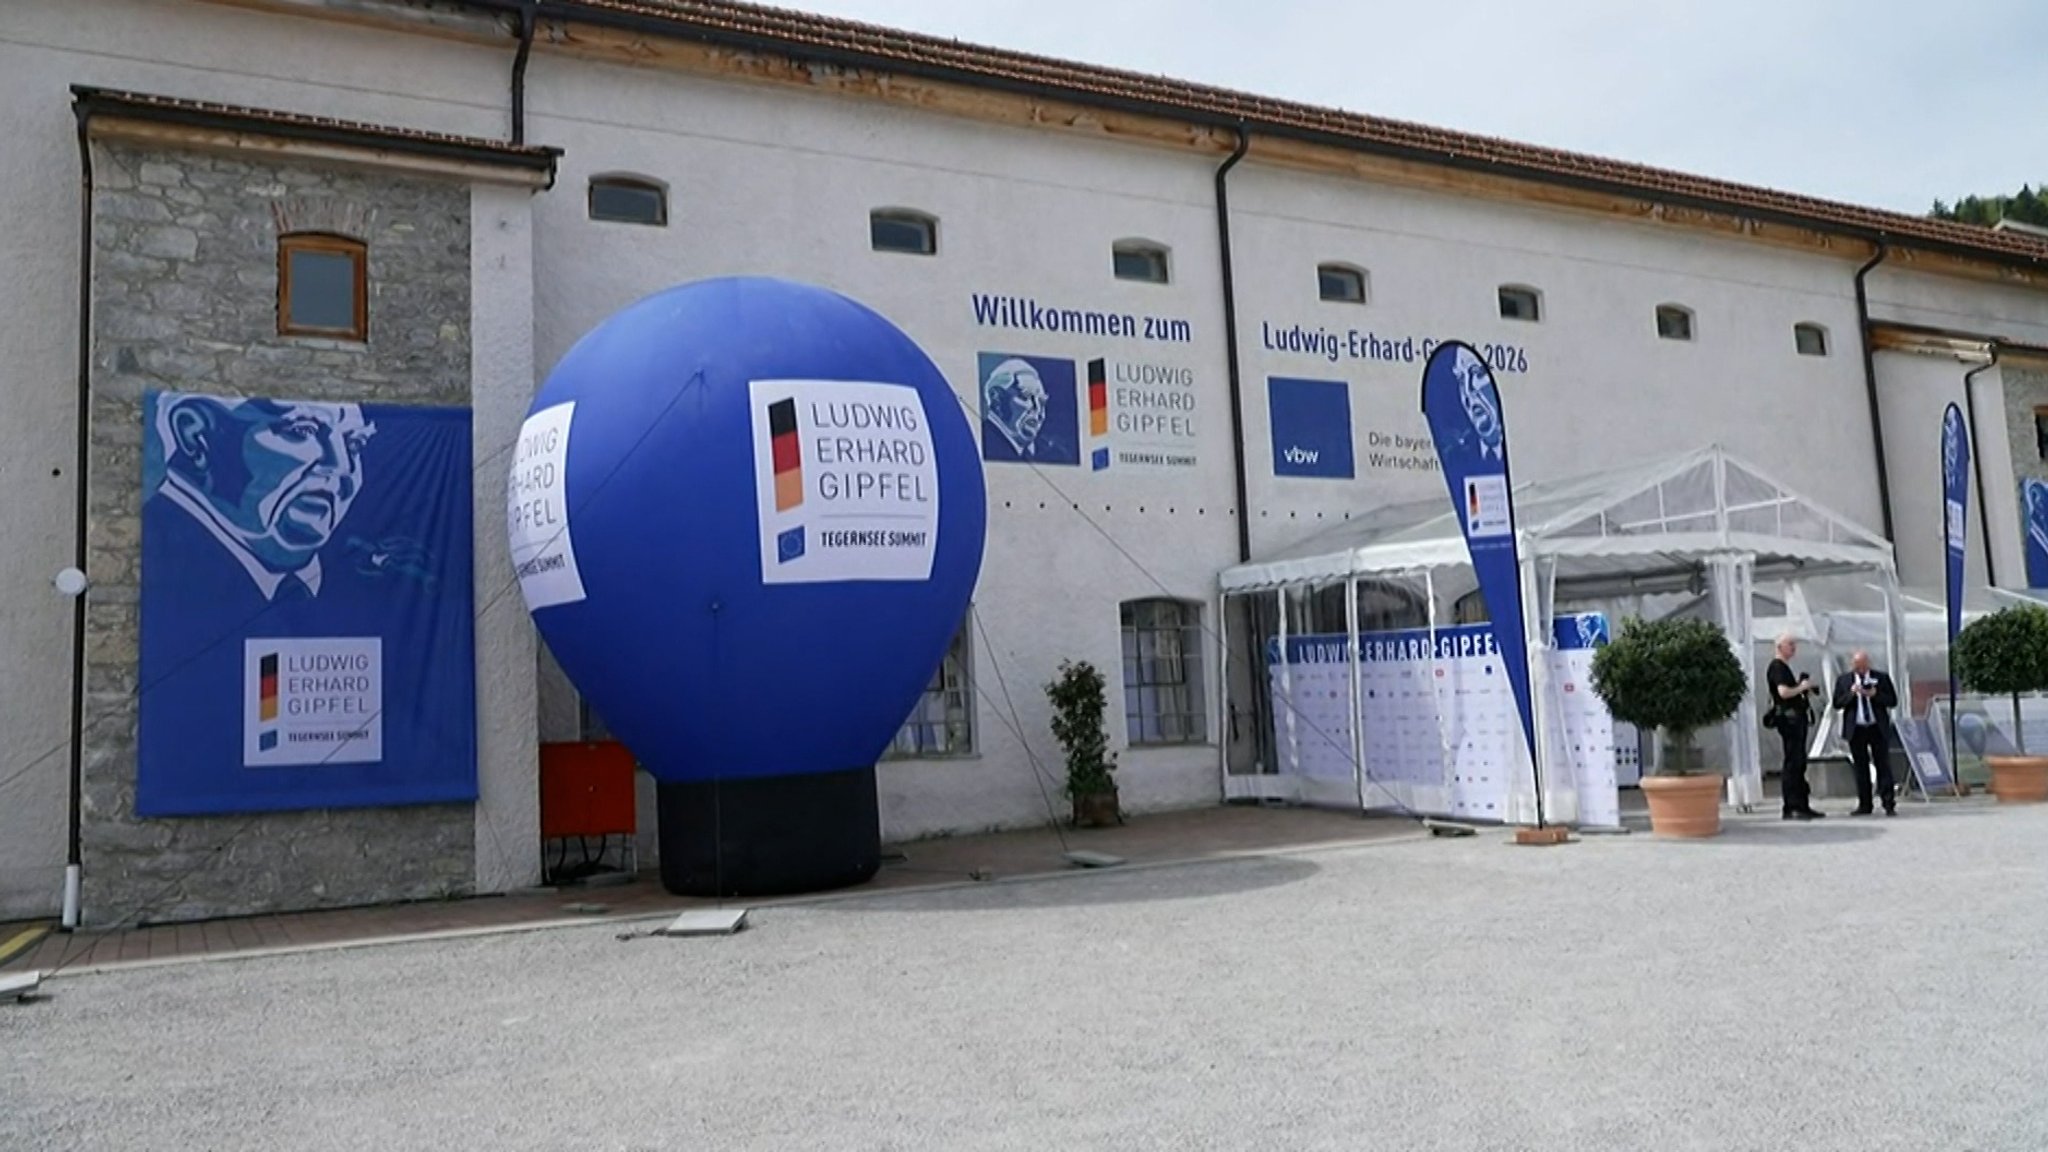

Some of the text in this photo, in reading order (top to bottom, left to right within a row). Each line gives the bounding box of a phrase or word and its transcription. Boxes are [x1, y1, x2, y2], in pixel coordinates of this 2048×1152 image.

[972, 293, 1191, 342] Willkommen zum
[1263, 320, 1528, 373] Ludwig-Erhard-G 2026
[1116, 363, 1194, 388] LUDWIG
[1116, 388, 1195, 412] ERHARD
[811, 402, 918, 432] LUDWIG
[1117, 412, 1197, 437] GIPFEL
[1369, 431, 1392, 447] Die
[817, 437, 926, 466] ERHARD
[1283, 445, 1319, 464] vbw
[819, 472, 928, 502] GIPFEL
[821, 530, 927, 548] TEGERNSEE SUMMIT
[288, 654, 369, 672] LUDWIG
[288, 676, 369, 694] ERHARD
[287, 696, 371, 716] GIPFEL
